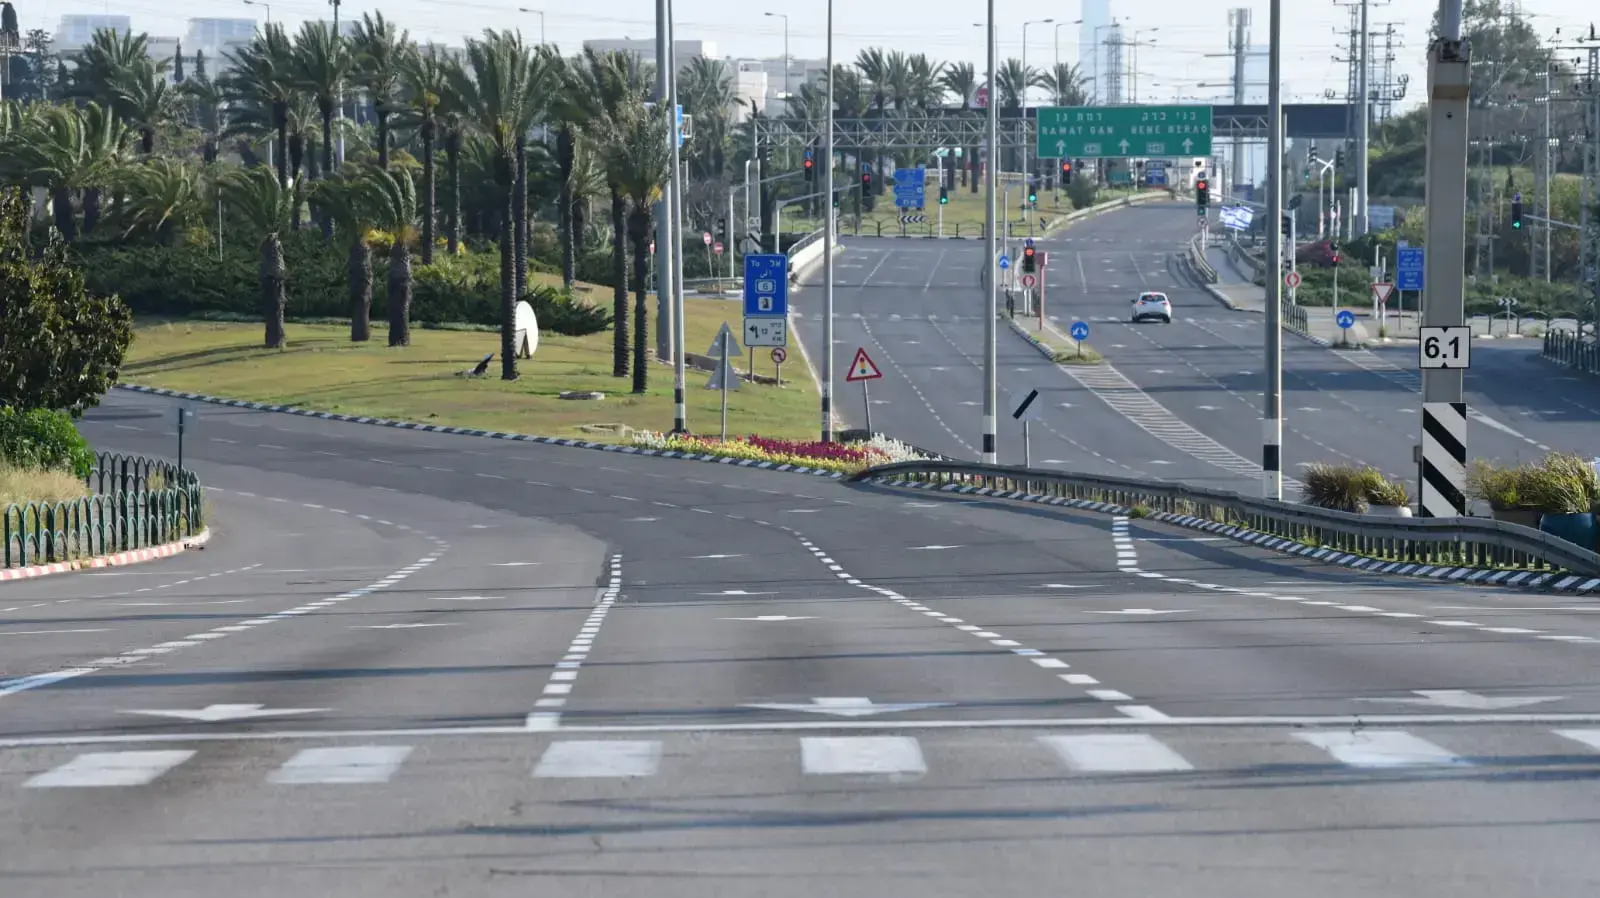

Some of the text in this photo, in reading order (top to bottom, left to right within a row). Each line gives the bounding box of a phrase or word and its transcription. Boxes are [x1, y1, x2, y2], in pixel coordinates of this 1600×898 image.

[1076, 112, 1102, 121] רמת
[1142, 111, 1196, 122] בני ברק
[1041, 125, 1113, 136] RAMAT GAN
[1424, 336, 1460, 359] 6.1
